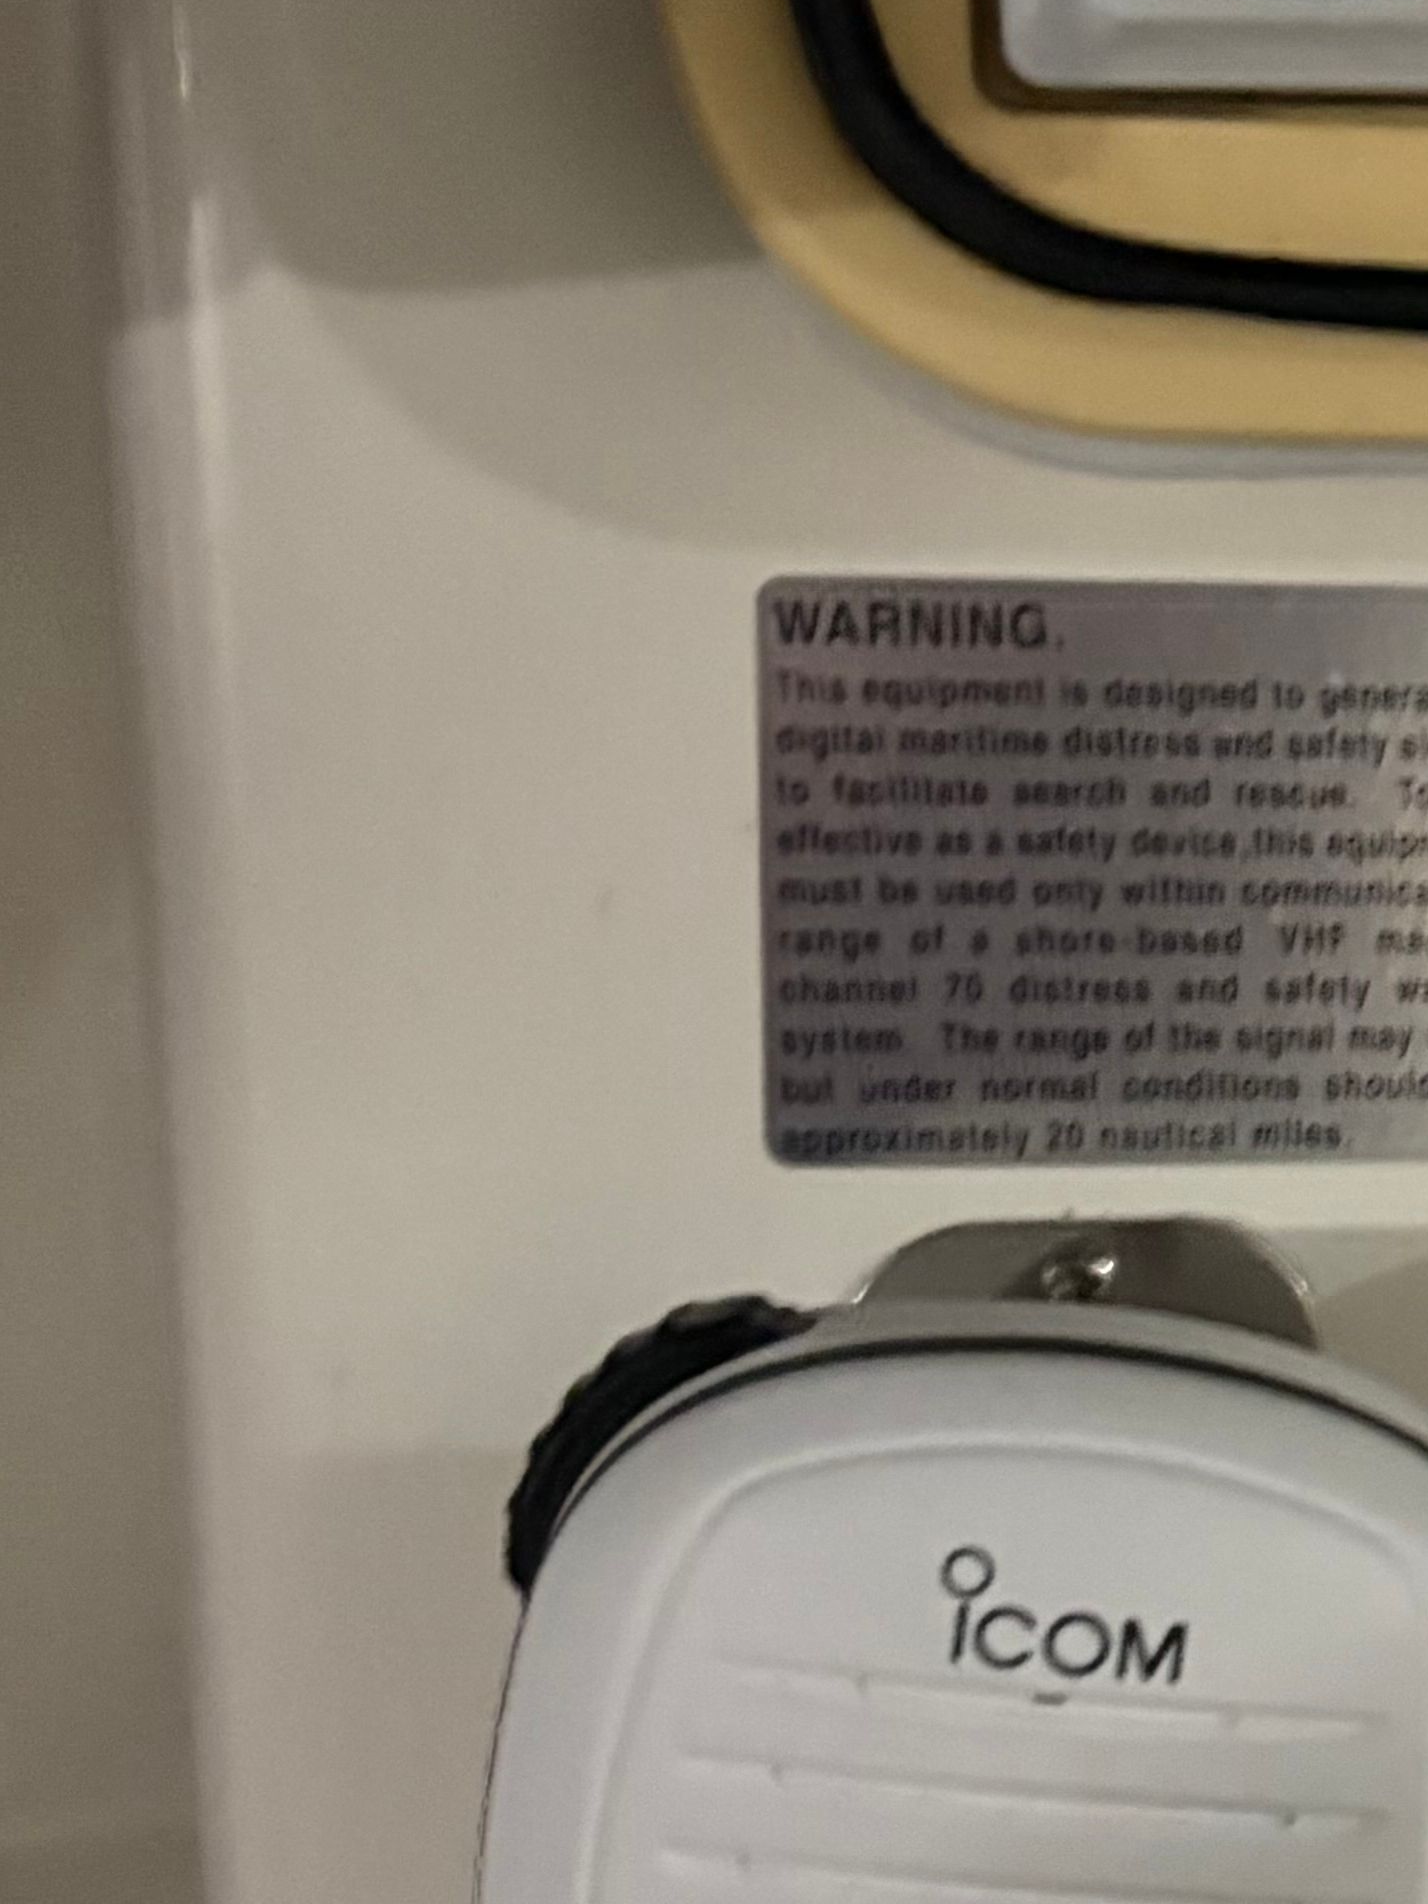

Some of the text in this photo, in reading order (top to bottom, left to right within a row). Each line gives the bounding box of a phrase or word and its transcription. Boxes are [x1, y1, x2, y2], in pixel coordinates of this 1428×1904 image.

[776, 670, 846, 705] This
[862, 678, 1046, 713] equipment
[1104, 676, 1257, 718] designed
[1272, 681, 1304, 710] to
[775, 726, 885, 766] digital
[1064, 725, 1200, 759] distress
[1288, 726, 1387, 768] safety
[776, 774, 810, 806] to
[776, 822, 922, 858] effective
[1017, 824, 1117, 863] safety
[778, 876, 862, 906] must
[1120, 876, 1226, 907] within
[778, 928, 881, 964] range
[910, 923, 945, 956] of
[944, 972, 985, 1006] 70
[1010, 974, 1152, 1005] distress
[1264, 972, 1372, 1014] safety
[939, 1021, 1000, 1054] The
[1013, 1028, 1111, 1062] range
[1123, 1022, 1155, 1055] of
[1168, 1022, 1222, 1054] the
[1235, 1020, 1337, 1062] signal
[1350, 1024, 1414, 1060] may
[860, 1074, 957, 1102] under
[980, 1070, 1099, 1103] normal
